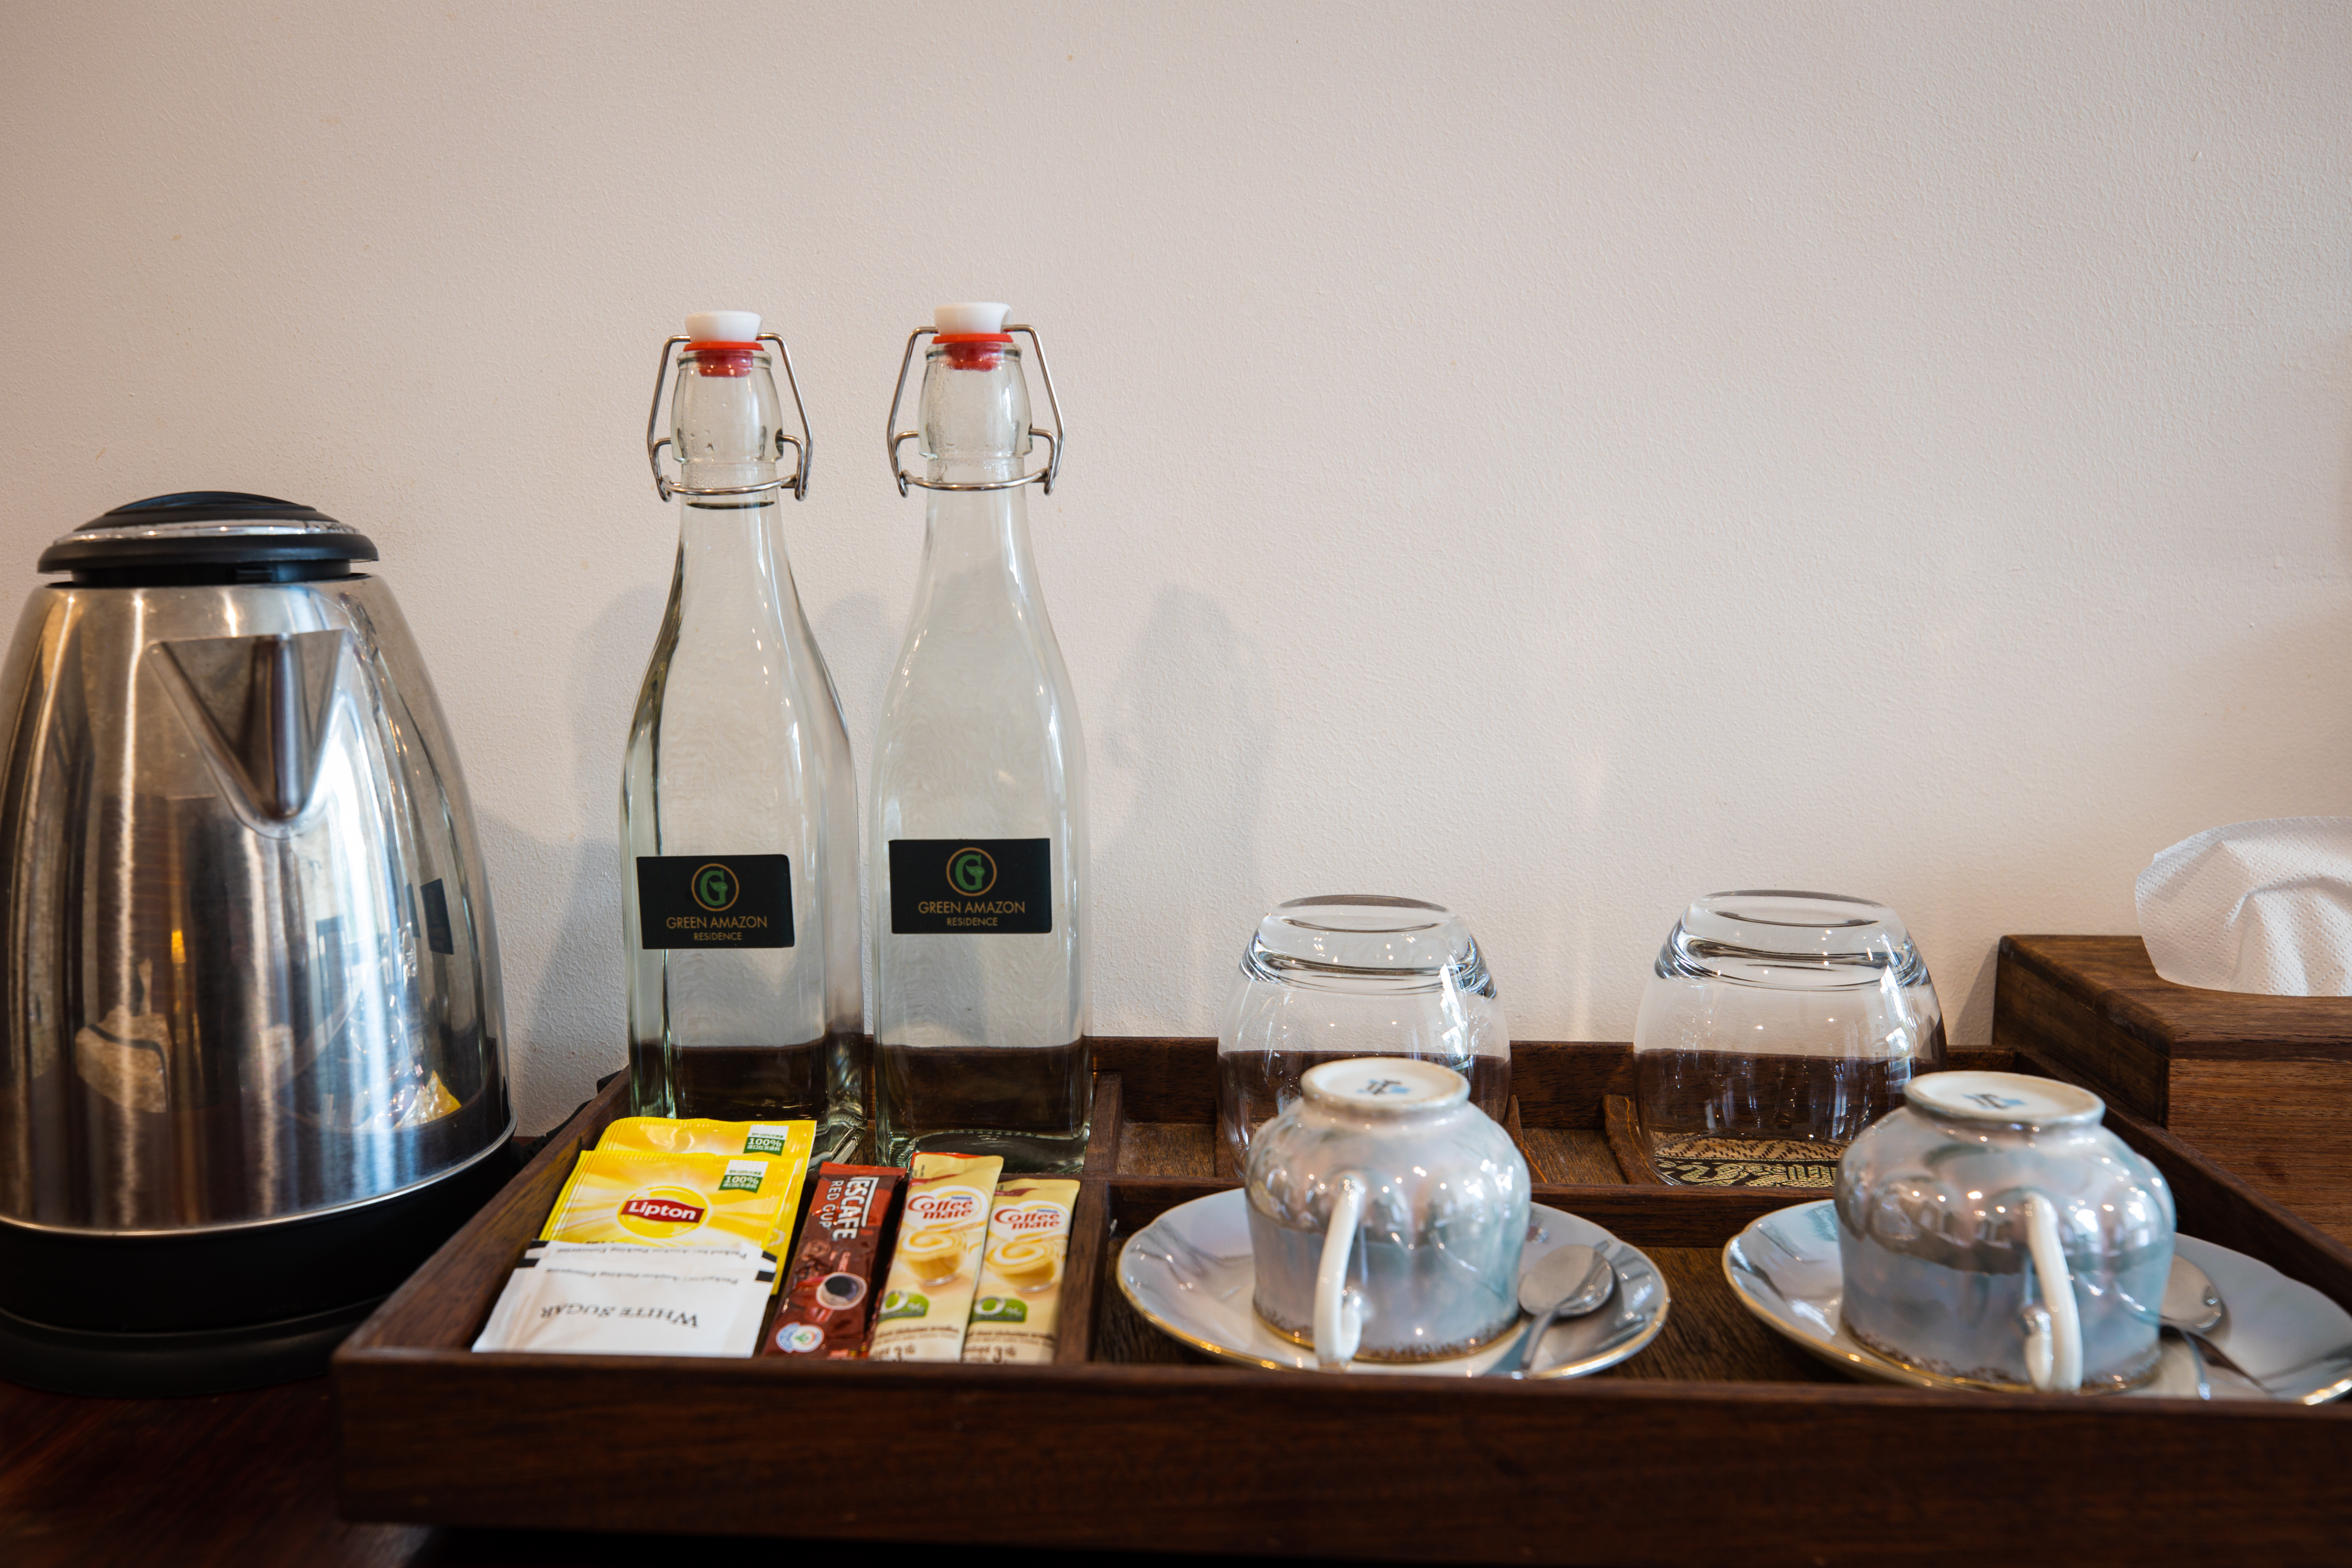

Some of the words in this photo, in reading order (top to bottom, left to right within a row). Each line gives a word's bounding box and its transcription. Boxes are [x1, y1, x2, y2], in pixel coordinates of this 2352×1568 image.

[918, 900, 962, 915] GREEN
[964, 900, 1026, 914] AMAZON
[666, 916, 707, 930] GREEN
[709, 915, 768, 929] AMAZON
[946, 916, 998, 927] RESIDENCE
[693, 931, 743, 942] RESIDENCE
[748, 1138, 782, 1148] 100%
[724, 1176, 759, 1185] 100%
[827, 1180, 845, 1200] RED
[628, 1200, 696, 1221] Lipton
[907, 1195, 973, 1212] Coffee
[819, 1204, 836, 1228] CUP
[922, 1207, 972, 1220] mate
[994, 1209, 1060, 1224] Coffee
[1011, 1219, 1060, 1230] mate
[541, 1302, 616, 1318] SUGAR
[619, 1307, 698, 1328] WHITE
